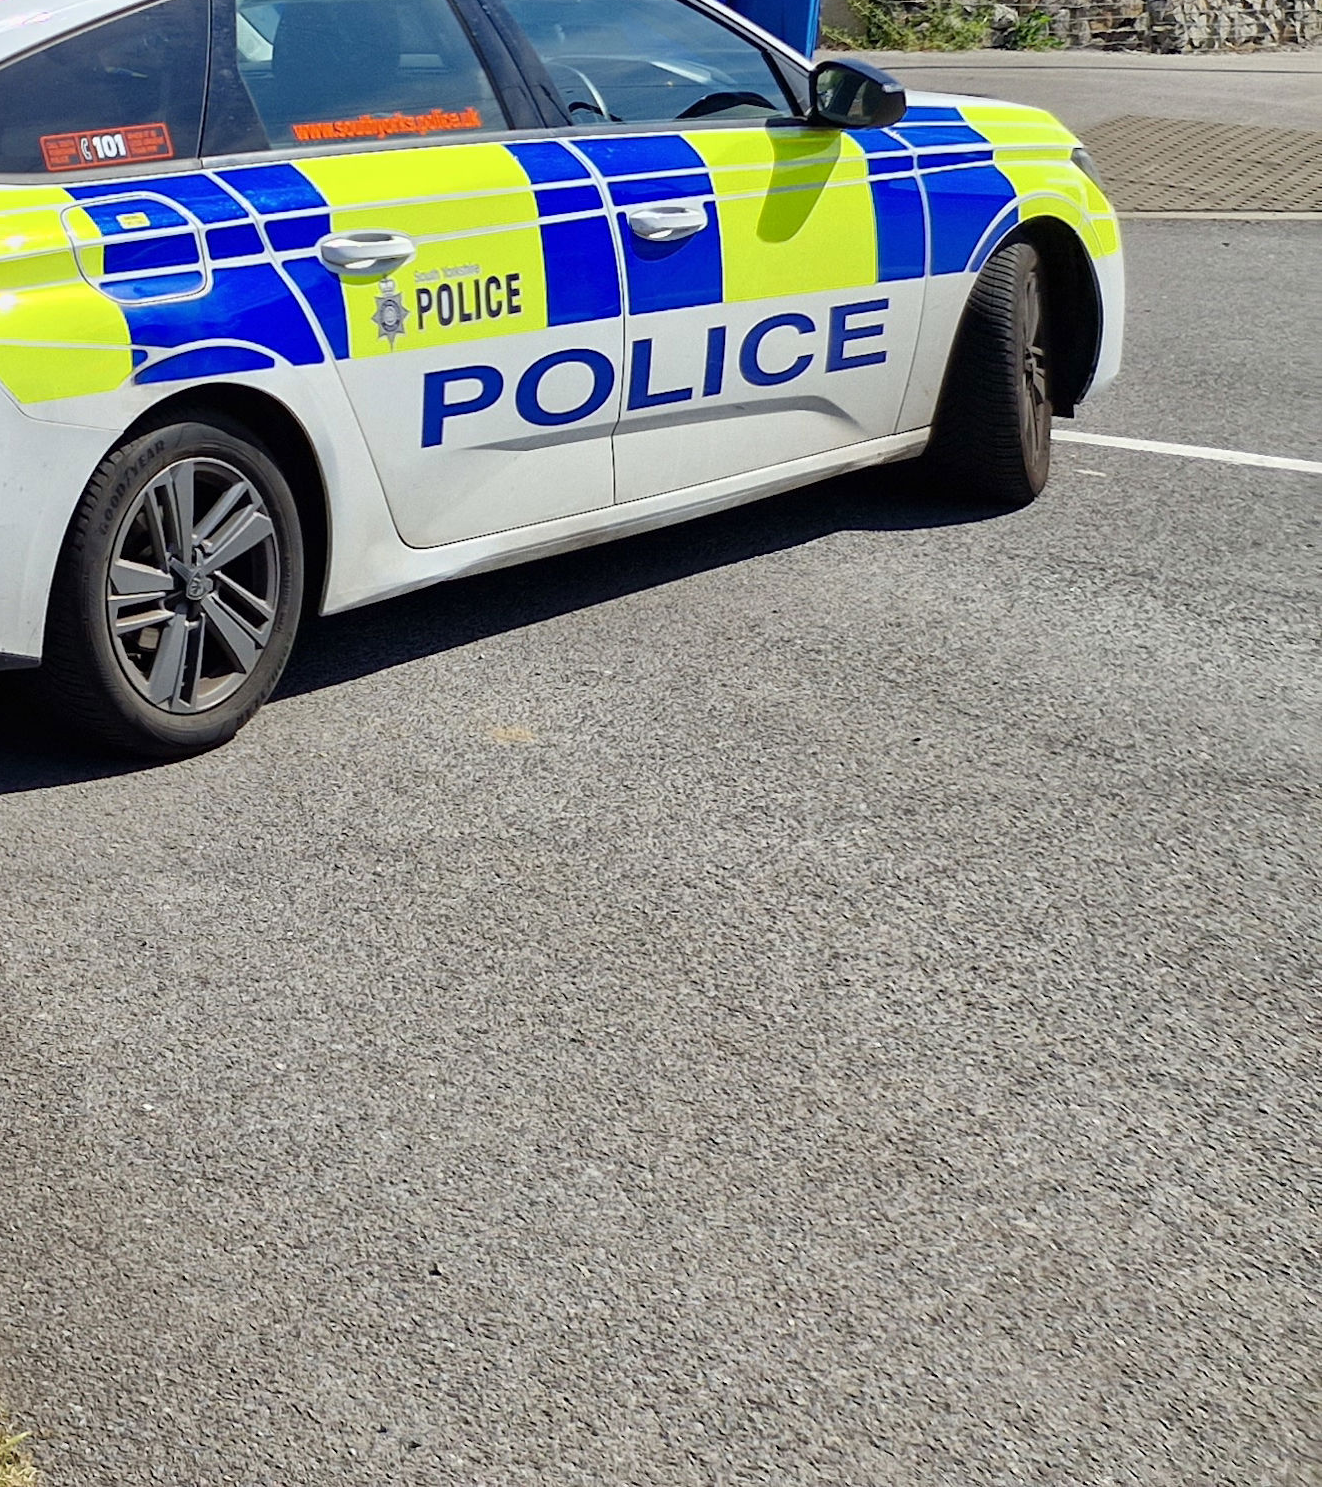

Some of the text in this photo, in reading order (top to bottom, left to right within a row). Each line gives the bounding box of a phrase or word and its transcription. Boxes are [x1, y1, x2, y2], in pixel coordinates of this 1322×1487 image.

[92, 133, 127, 159] 101
[416, 273, 522, 330] POLICE
[421, 298, 890, 448] POLICE
